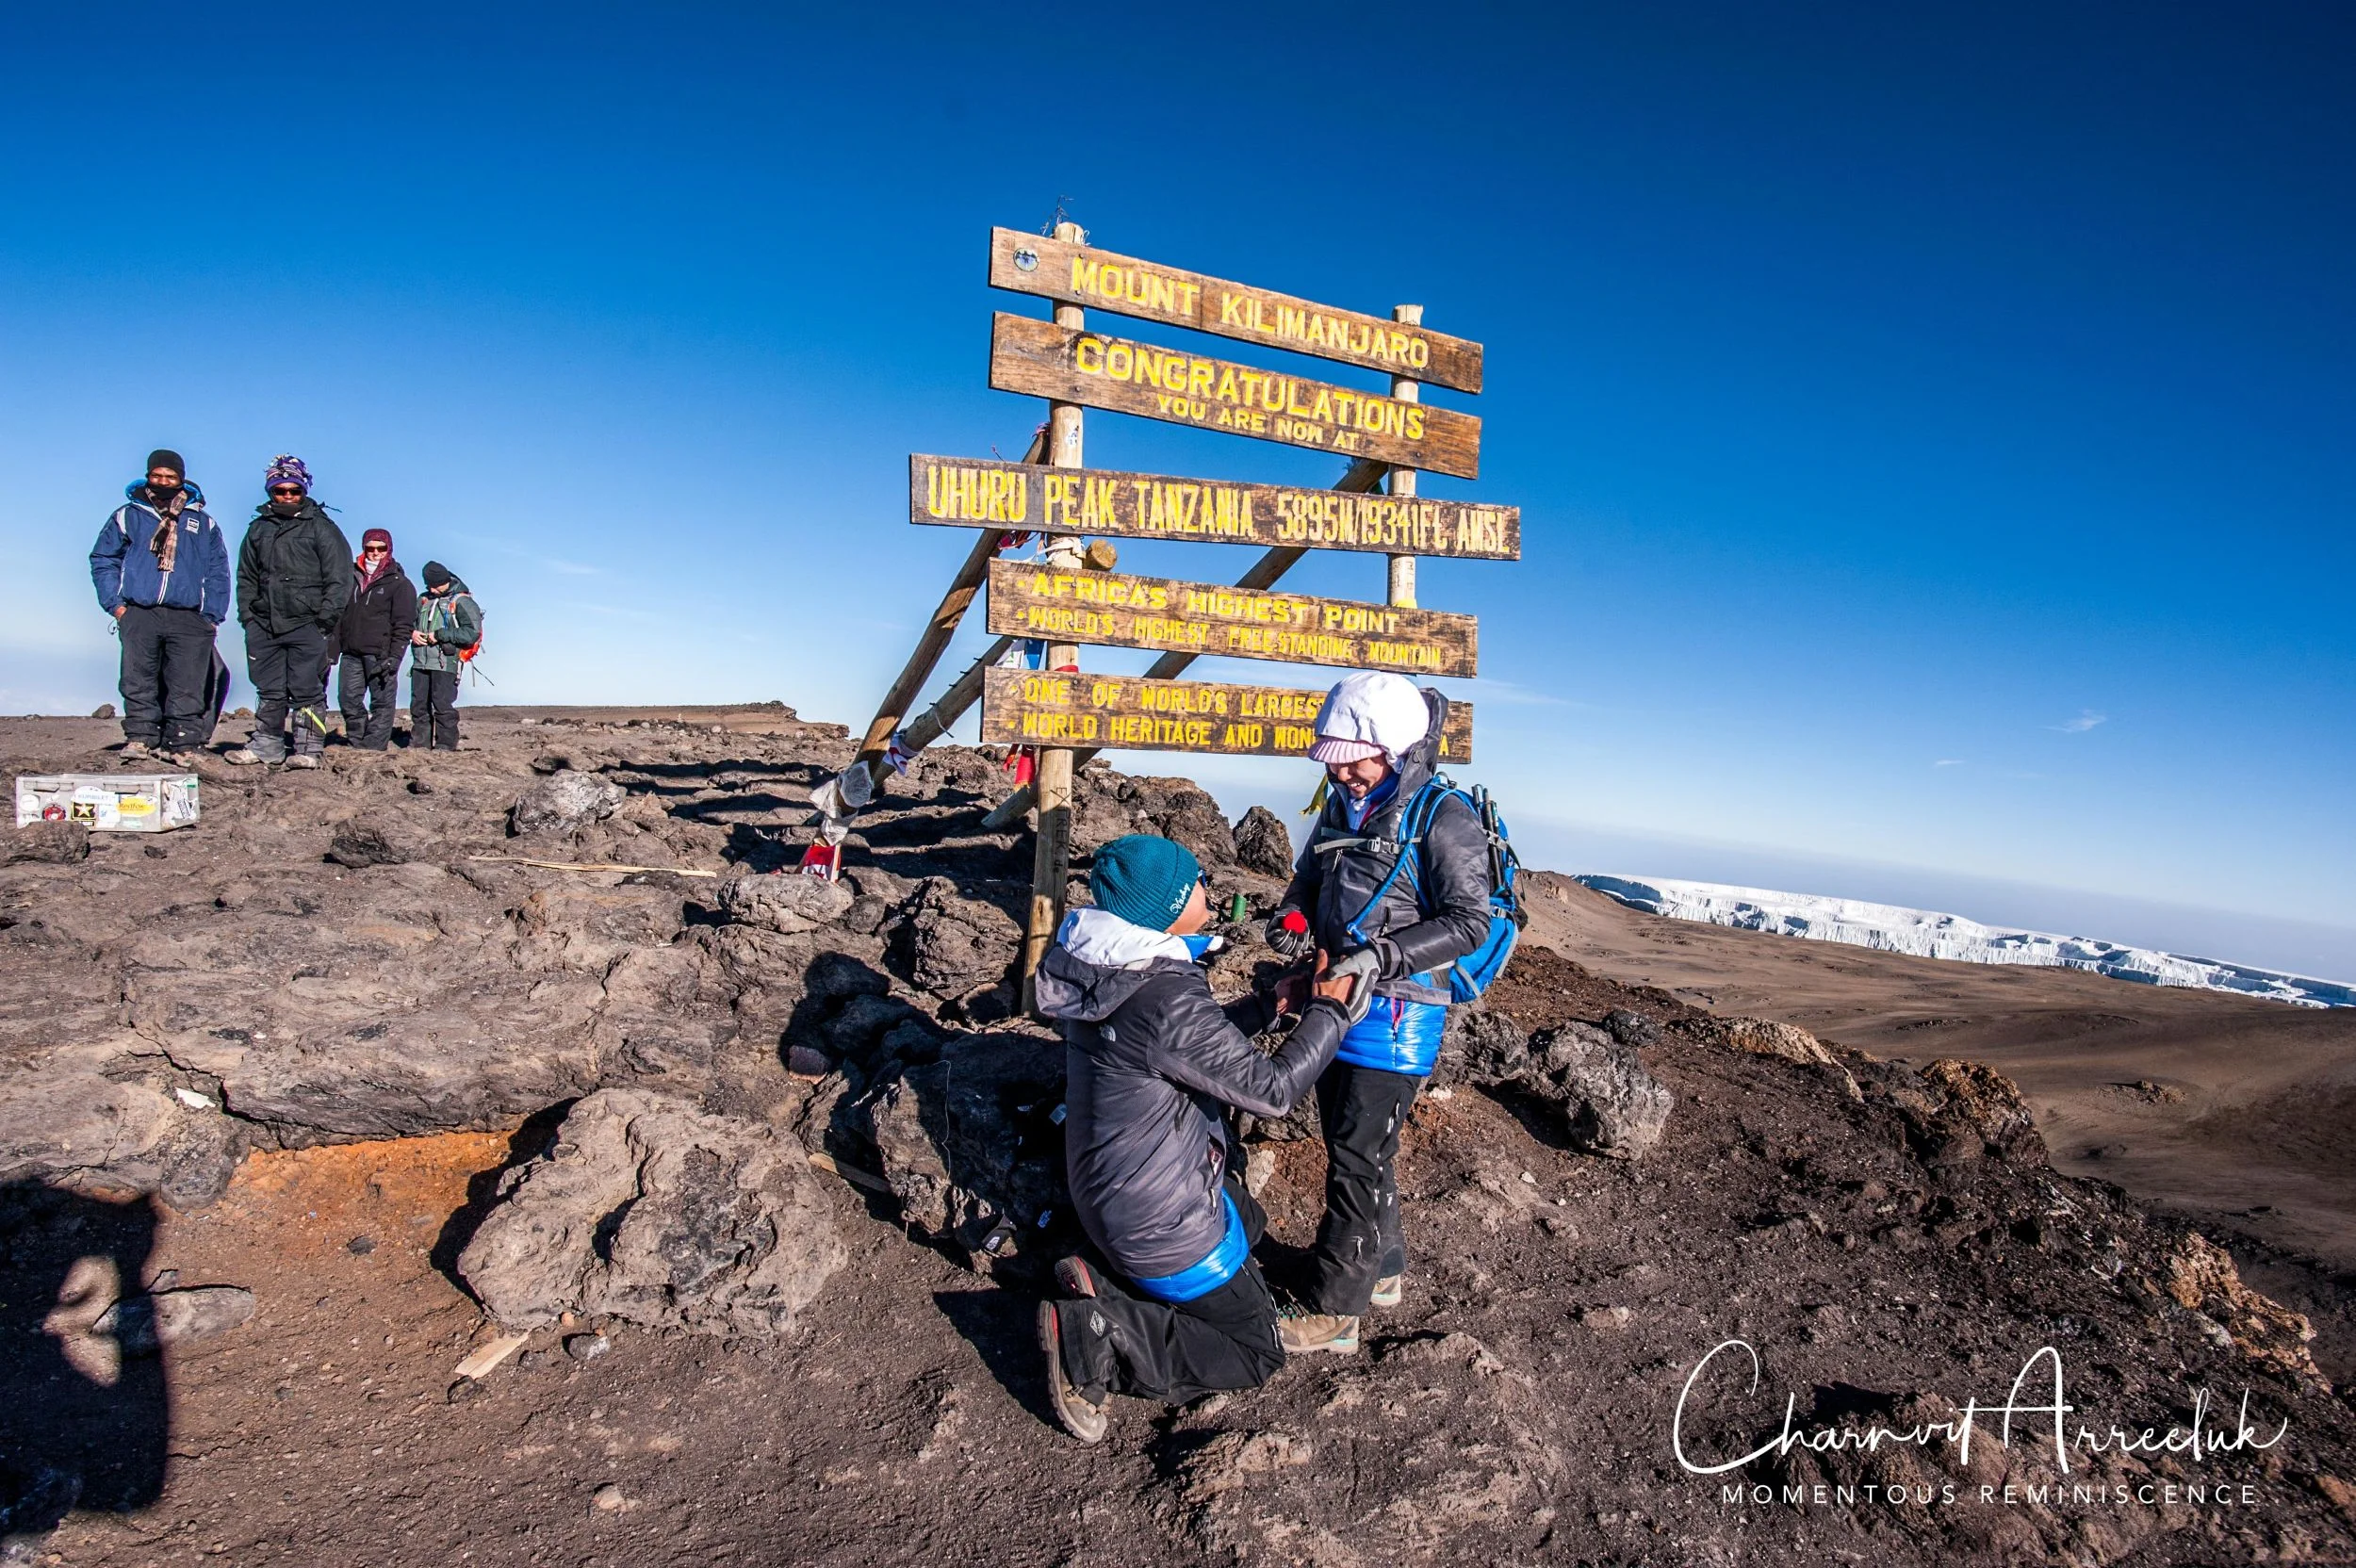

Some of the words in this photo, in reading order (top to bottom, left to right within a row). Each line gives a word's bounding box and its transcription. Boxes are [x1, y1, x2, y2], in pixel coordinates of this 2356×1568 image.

[1071, 255, 1200, 316] MOUNT
[1221, 292, 1429, 368] KILIMANJARO
[1076, 336, 1425, 440] CONGRATULATIONS
[1156, 393, 1206, 420] YOU
[1218, 407, 1267, 433] ARE
[1333, 430, 1359, 450] AT
[927, 466, 1027, 523] UHURU
[1044, 474, 1119, 529] PEAK
[1456, 508, 1510, 553] AMSL
[1186, 589, 1309, 625] HIGHEST
[1324, 605, 1399, 634] POINT
[1134, 615, 1210, 645] HIGHEST
[1368, 641, 1441, 667] MOUNTAIN
[1024, 677, 1071, 705] ONE
[1092, 681, 1123, 709] OF
[1022, 711, 1098, 740] WORLD
[1110, 716, 1212, 745] HERITAGE
[1223, 723, 1264, 748] AND
